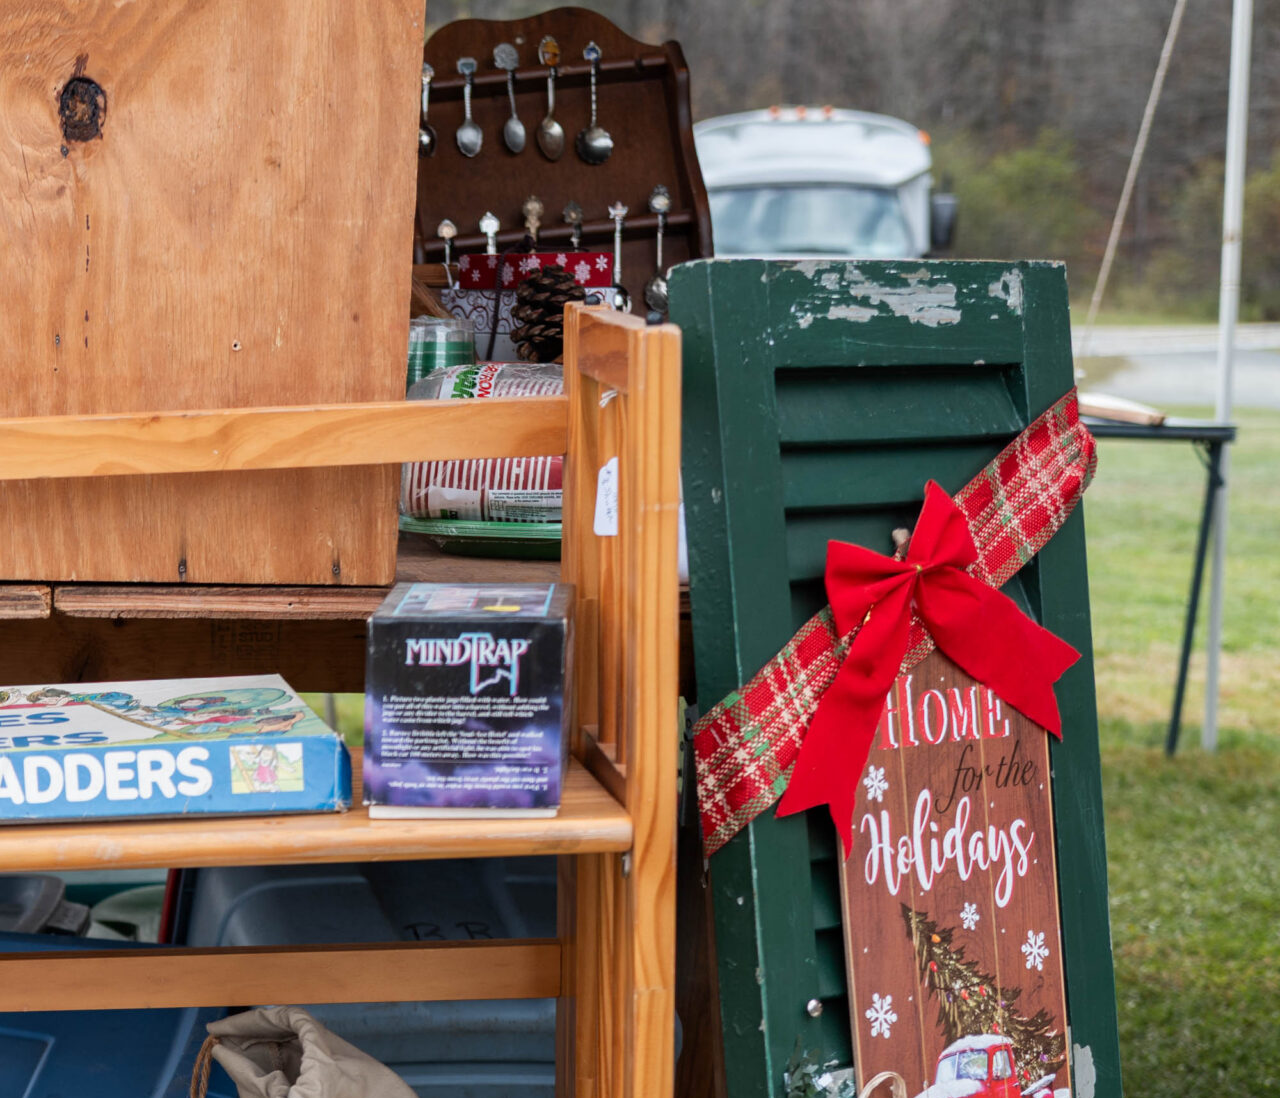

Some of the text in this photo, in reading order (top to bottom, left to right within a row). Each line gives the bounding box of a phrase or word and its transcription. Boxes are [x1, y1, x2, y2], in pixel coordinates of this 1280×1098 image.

[405, 632, 529, 695] MINDTRAP
[877, 674, 1010, 750] HOME
[935, 740, 1037, 814] for the
[860, 788, 1036, 908] Holidays
